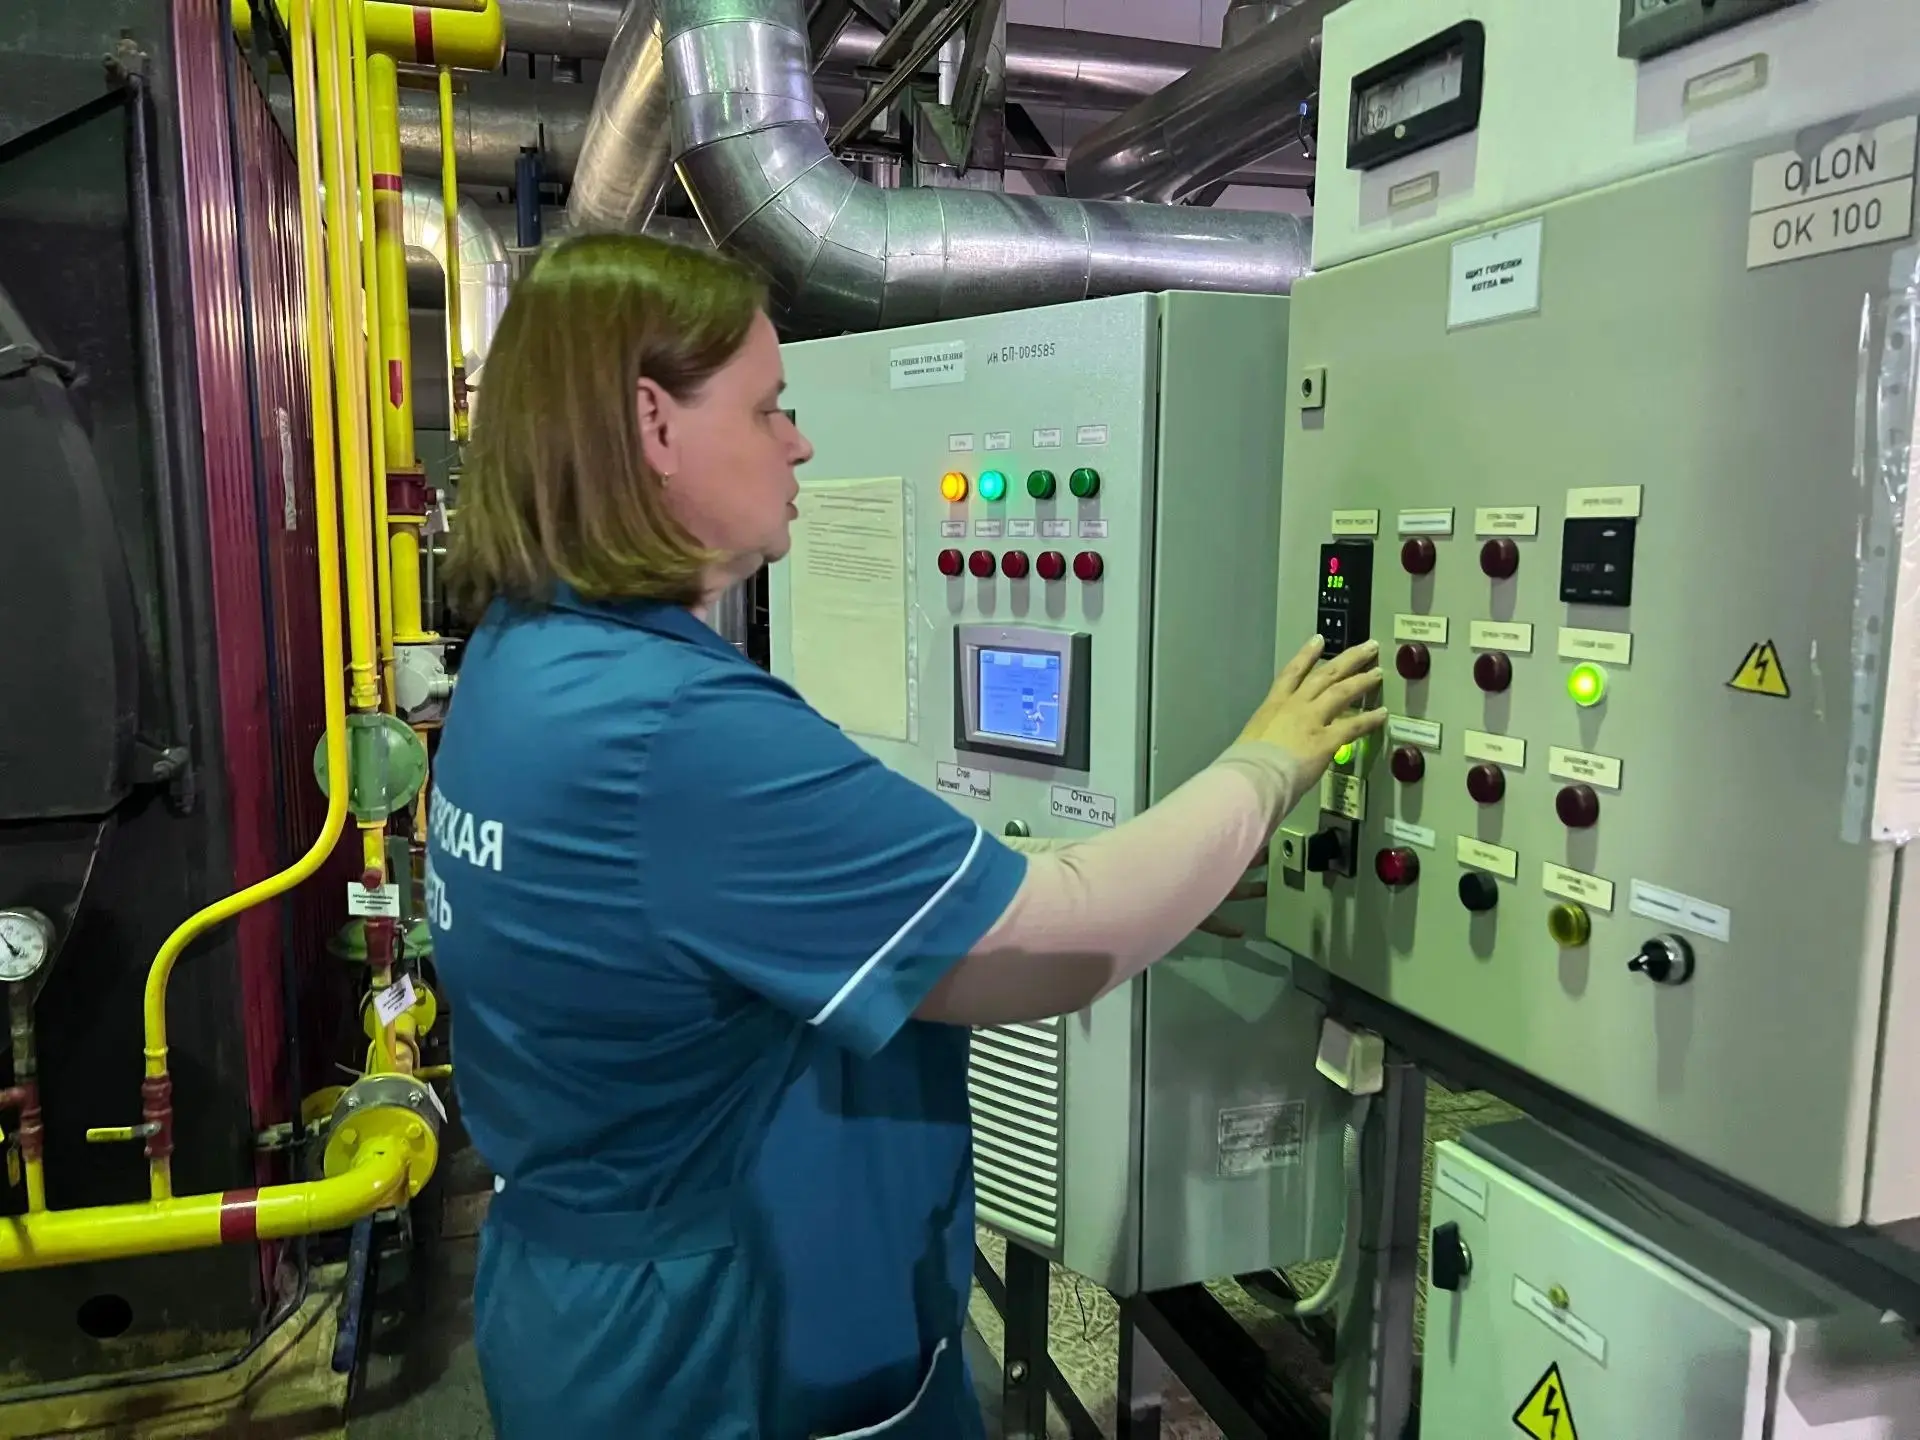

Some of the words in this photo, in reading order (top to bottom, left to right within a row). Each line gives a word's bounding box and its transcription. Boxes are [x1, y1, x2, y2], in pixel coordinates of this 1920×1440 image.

[1772, 213, 1816, 249] OK
[1832, 197, 1882, 237] 100
[1485, 257, 1523, 275] ГОРЕЛКИ
[1471, 278, 1498, 292] КОТЛА
[920, 351, 963, 364] УПРАВЛЕНИЯ
[1052, 801, 1062, 813] От
[1089, 808, 1099, 819] От
